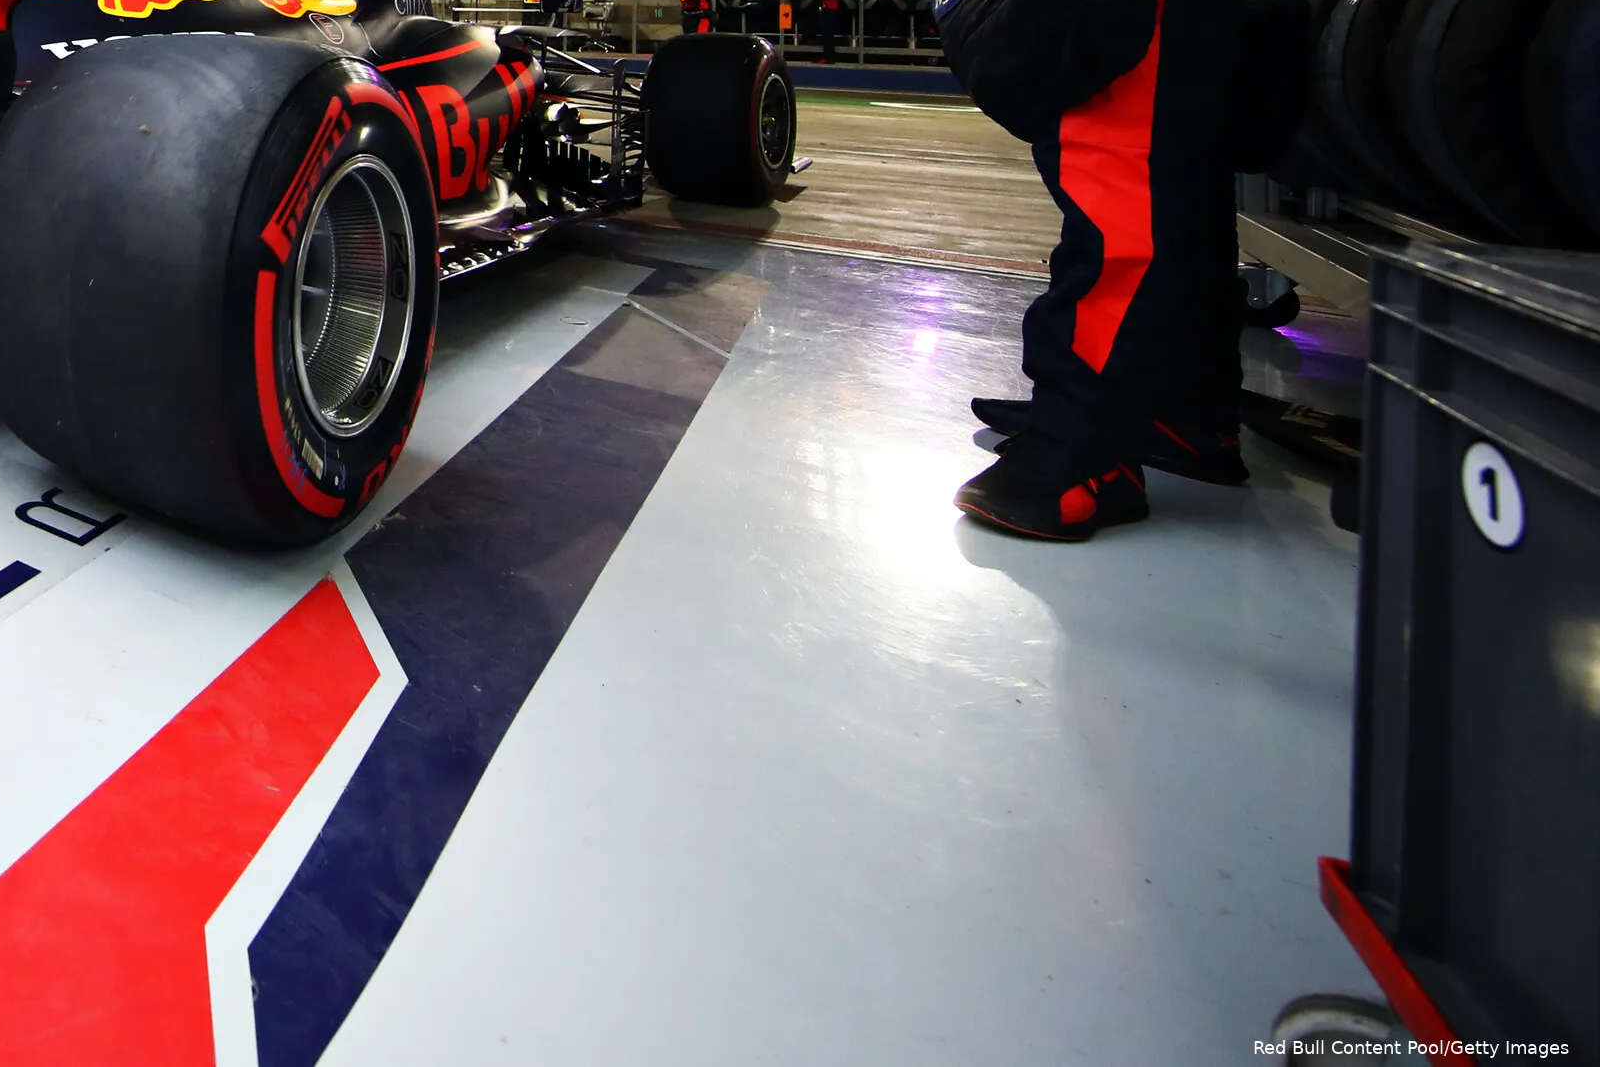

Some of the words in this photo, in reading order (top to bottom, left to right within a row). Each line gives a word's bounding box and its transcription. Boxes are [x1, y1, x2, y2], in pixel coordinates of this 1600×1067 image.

[260, 96, 353, 266] PIRELLI
[415, 61, 536, 200] Bull
[1479, 466, 1502, 523] 1
